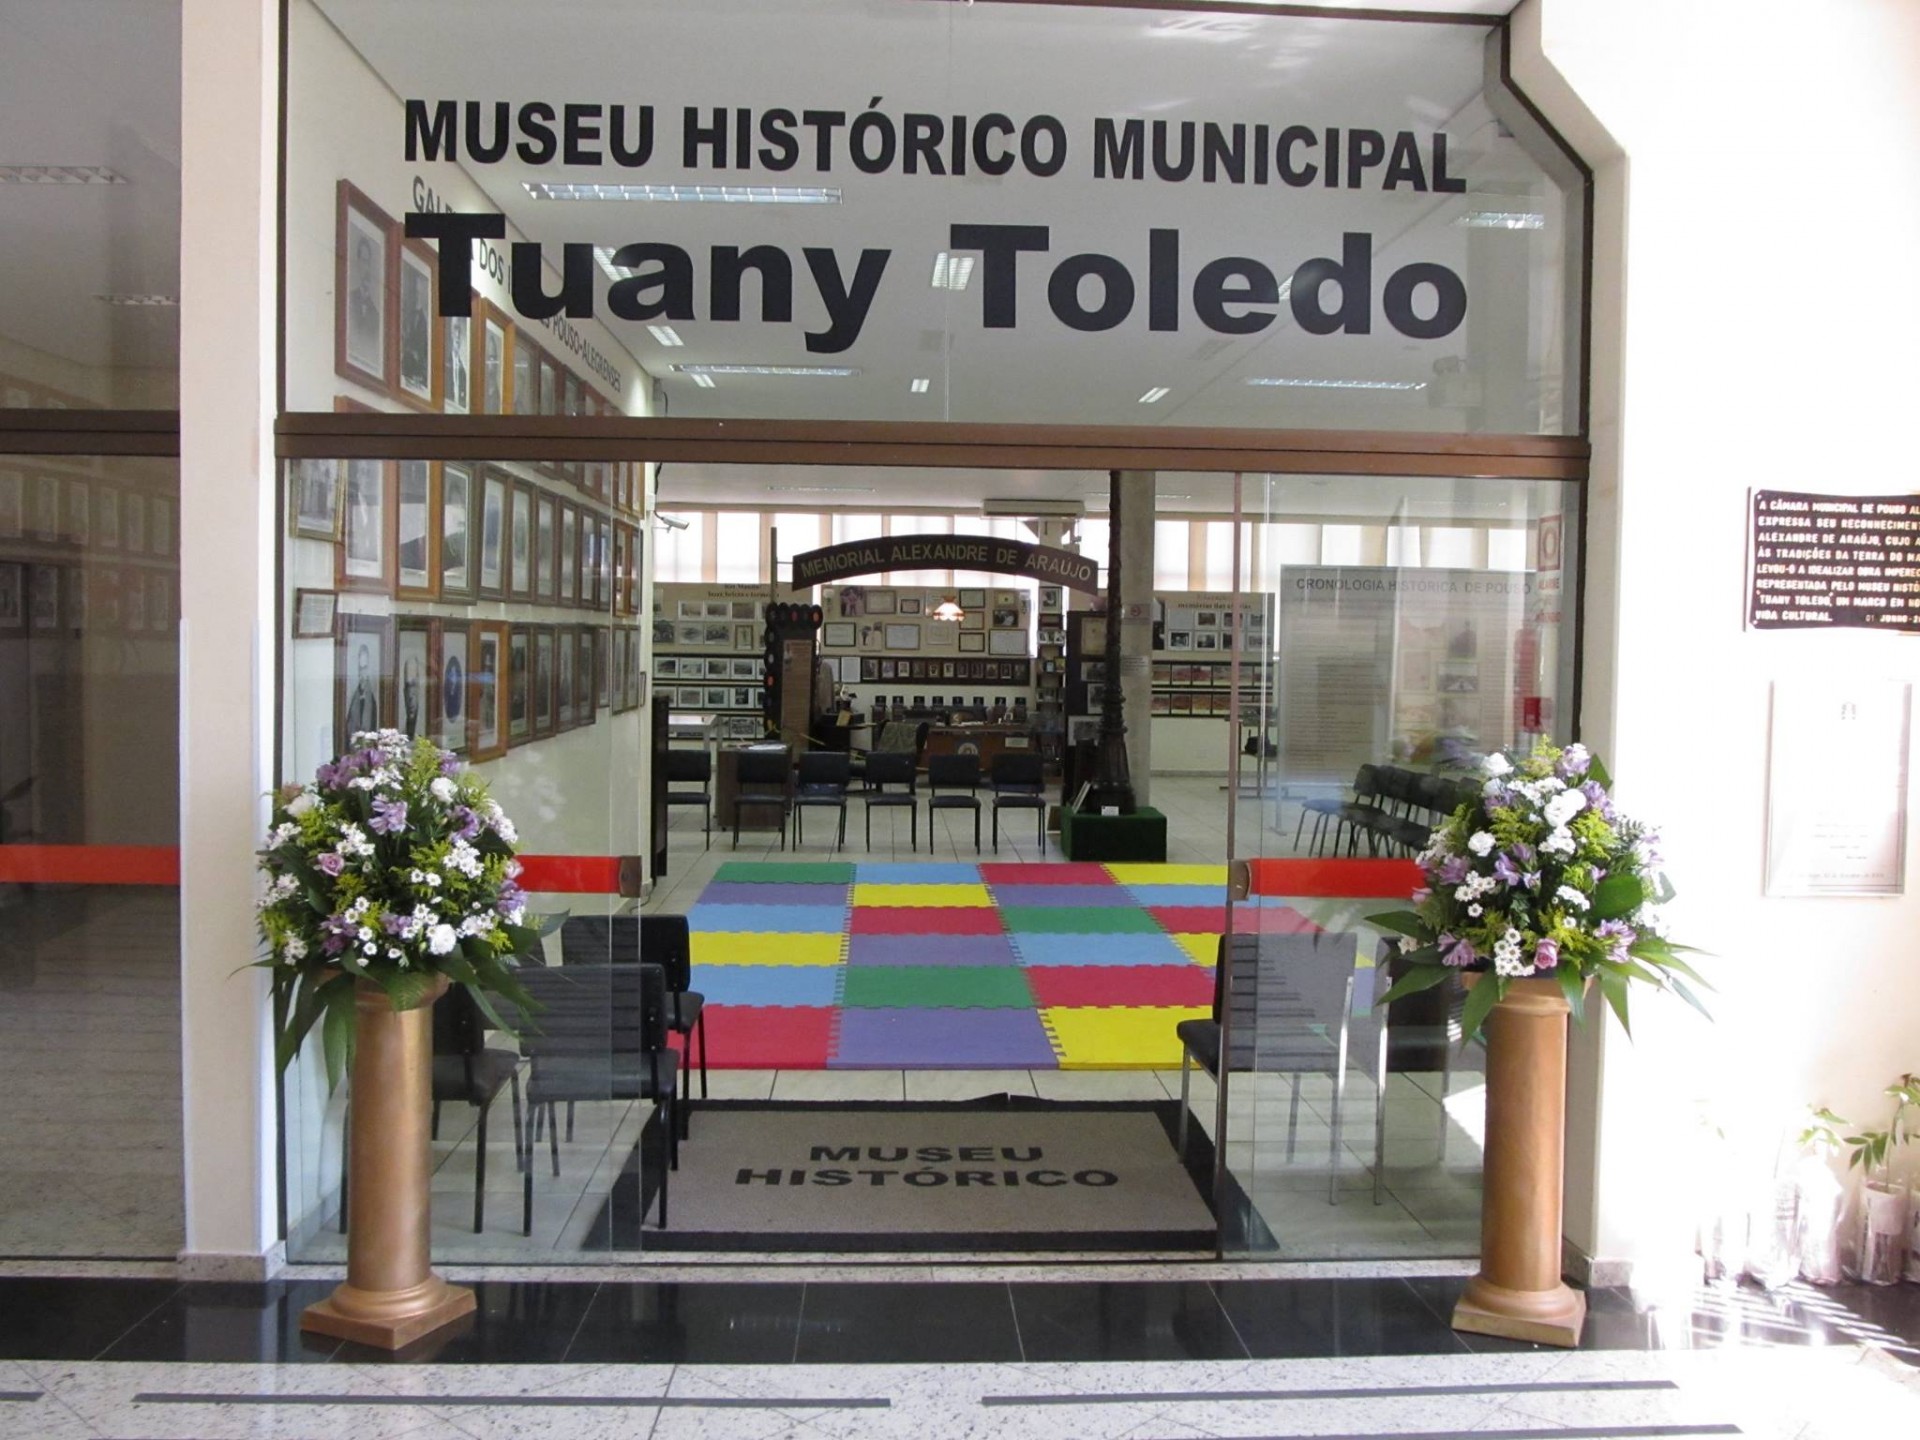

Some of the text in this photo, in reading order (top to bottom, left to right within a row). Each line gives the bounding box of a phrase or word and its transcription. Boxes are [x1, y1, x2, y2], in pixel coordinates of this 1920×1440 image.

[404, 96, 1467, 193] MUSEU HISTÓRICO MUNICIPAL
[404, 212, 1467, 354] Tuany Toledo
[1759, 500, 1767, 511] A
[801, 543, 1092, 582] MEMORIAL ALEXANDRE DE ARAÚJO
[1296, 578, 1385, 592] CRONOLOGIA
[1465, 581, 1482, 594] DE
[735, 1146, 1119, 1187] MUSEU HISTÓRICO
